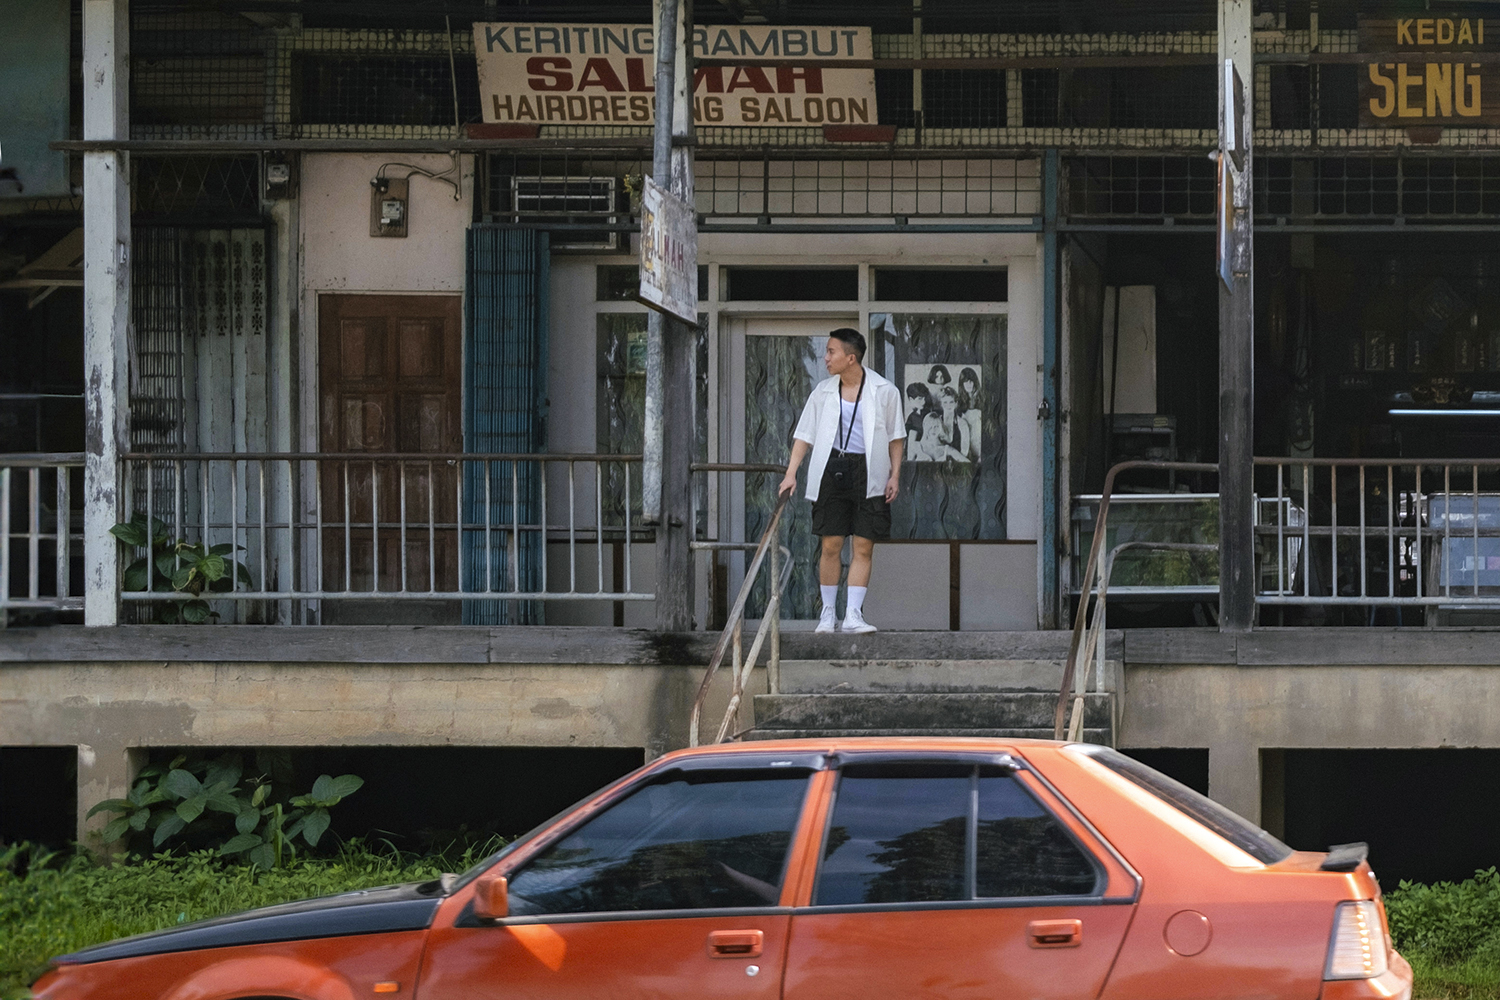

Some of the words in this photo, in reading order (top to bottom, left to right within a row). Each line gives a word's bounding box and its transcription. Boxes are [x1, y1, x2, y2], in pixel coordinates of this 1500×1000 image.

[485, 26, 654, 55] KERITING
[693, 28, 859, 57] RAMBUT
[1396, 18, 1484, 46] KEDAI
[1368, 52, 1482, 118] SENG
[492, 94, 724, 123] HAIRDRESG
[741, 96, 869, 125] SALOON
